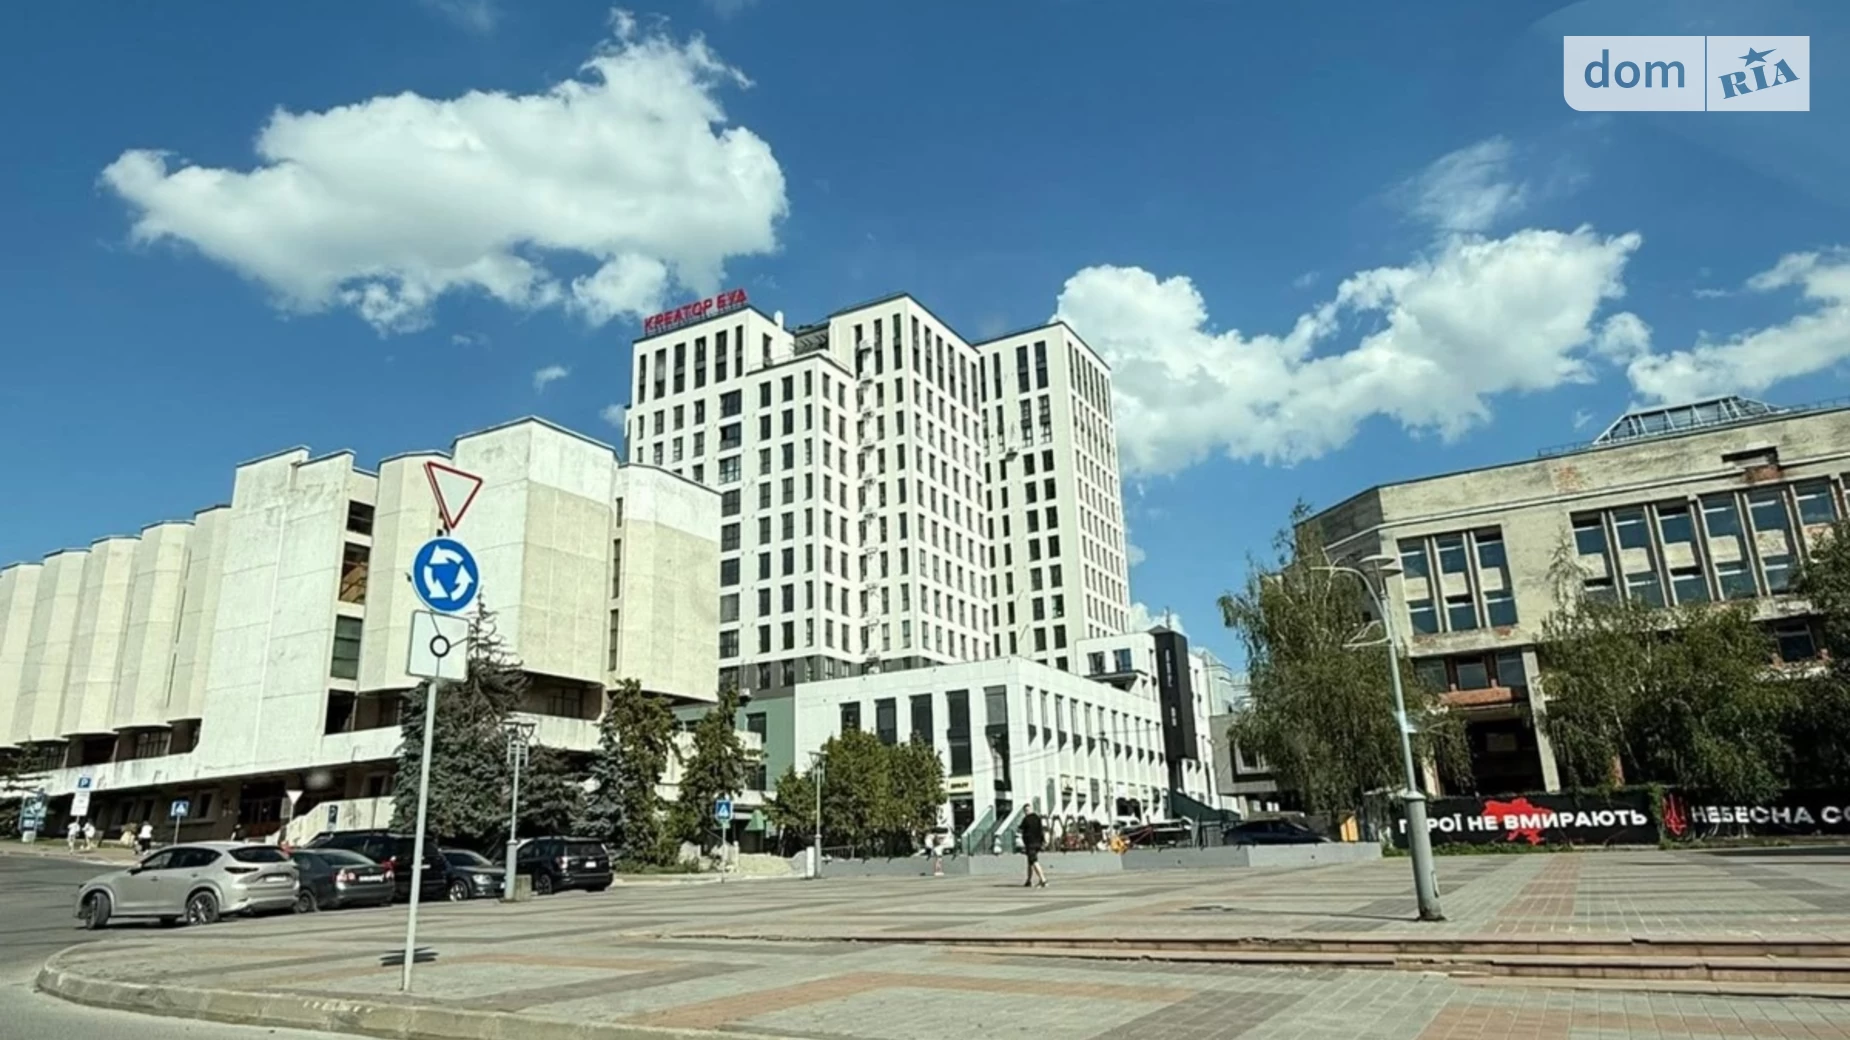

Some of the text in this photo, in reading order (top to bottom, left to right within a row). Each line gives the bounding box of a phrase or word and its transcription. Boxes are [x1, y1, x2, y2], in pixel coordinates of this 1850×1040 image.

[644, 298, 713, 333] КРЕАТОР
[1398, 810, 1648, 834] ГРОЇ НЕ ВМИРАЮТЬ
[1691, 805, 1815, 824] НЕБЕСНА
